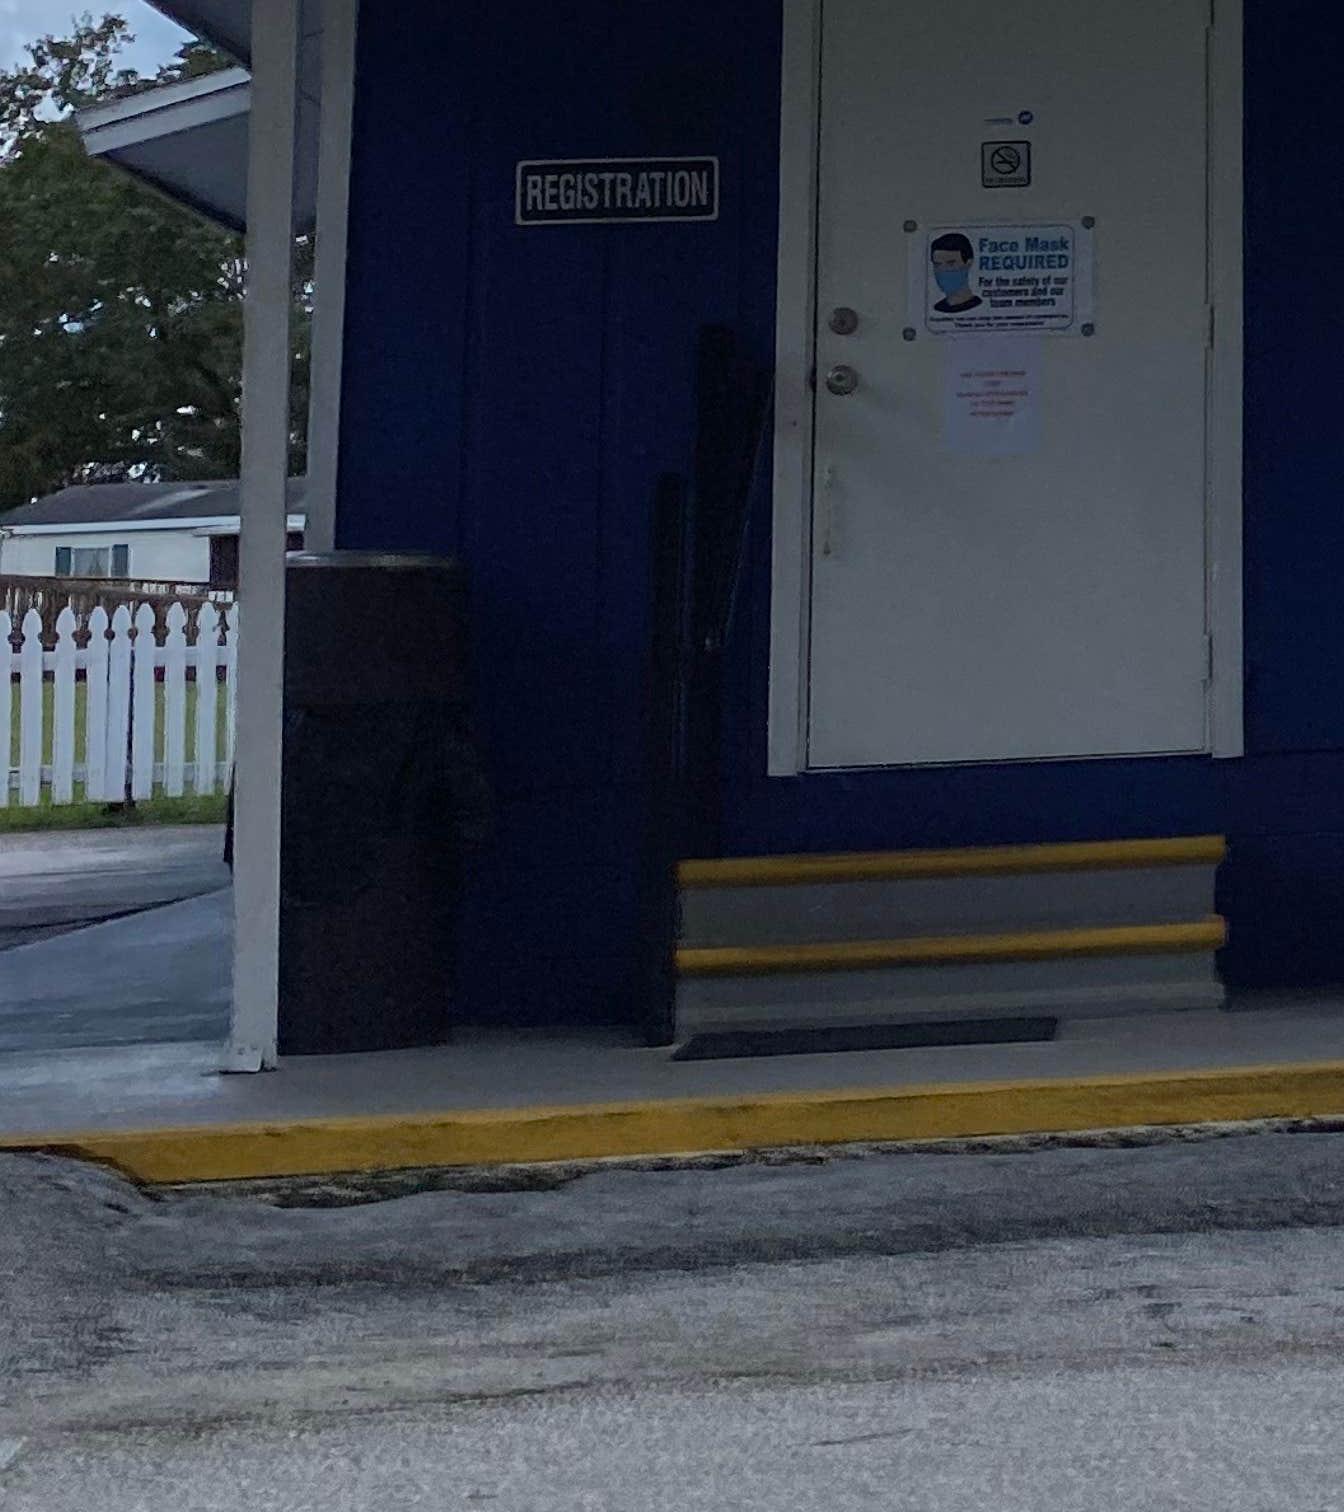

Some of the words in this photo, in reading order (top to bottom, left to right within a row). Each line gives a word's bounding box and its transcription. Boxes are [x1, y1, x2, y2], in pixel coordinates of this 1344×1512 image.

[526, 170, 709, 211] REGISTRATION
[979, 238, 1019, 253] Face
[1025, 236, 1070, 252] Mask
[978, 254, 1069, 271] REQUIRED
[979, 276, 993, 287] For
[995, 276, 1010, 286] the
[1012, 276, 1039, 288] safety
[1042, 275, 1051, 285] of
[1054, 277, 1068, 285] our
[982, 288, 1029, 297] customers
[1031, 287, 1047, 297] and
[1050, 287, 1064, 296] our
[991, 298, 1013, 307] team
[1015, 297, 1056, 307] members
